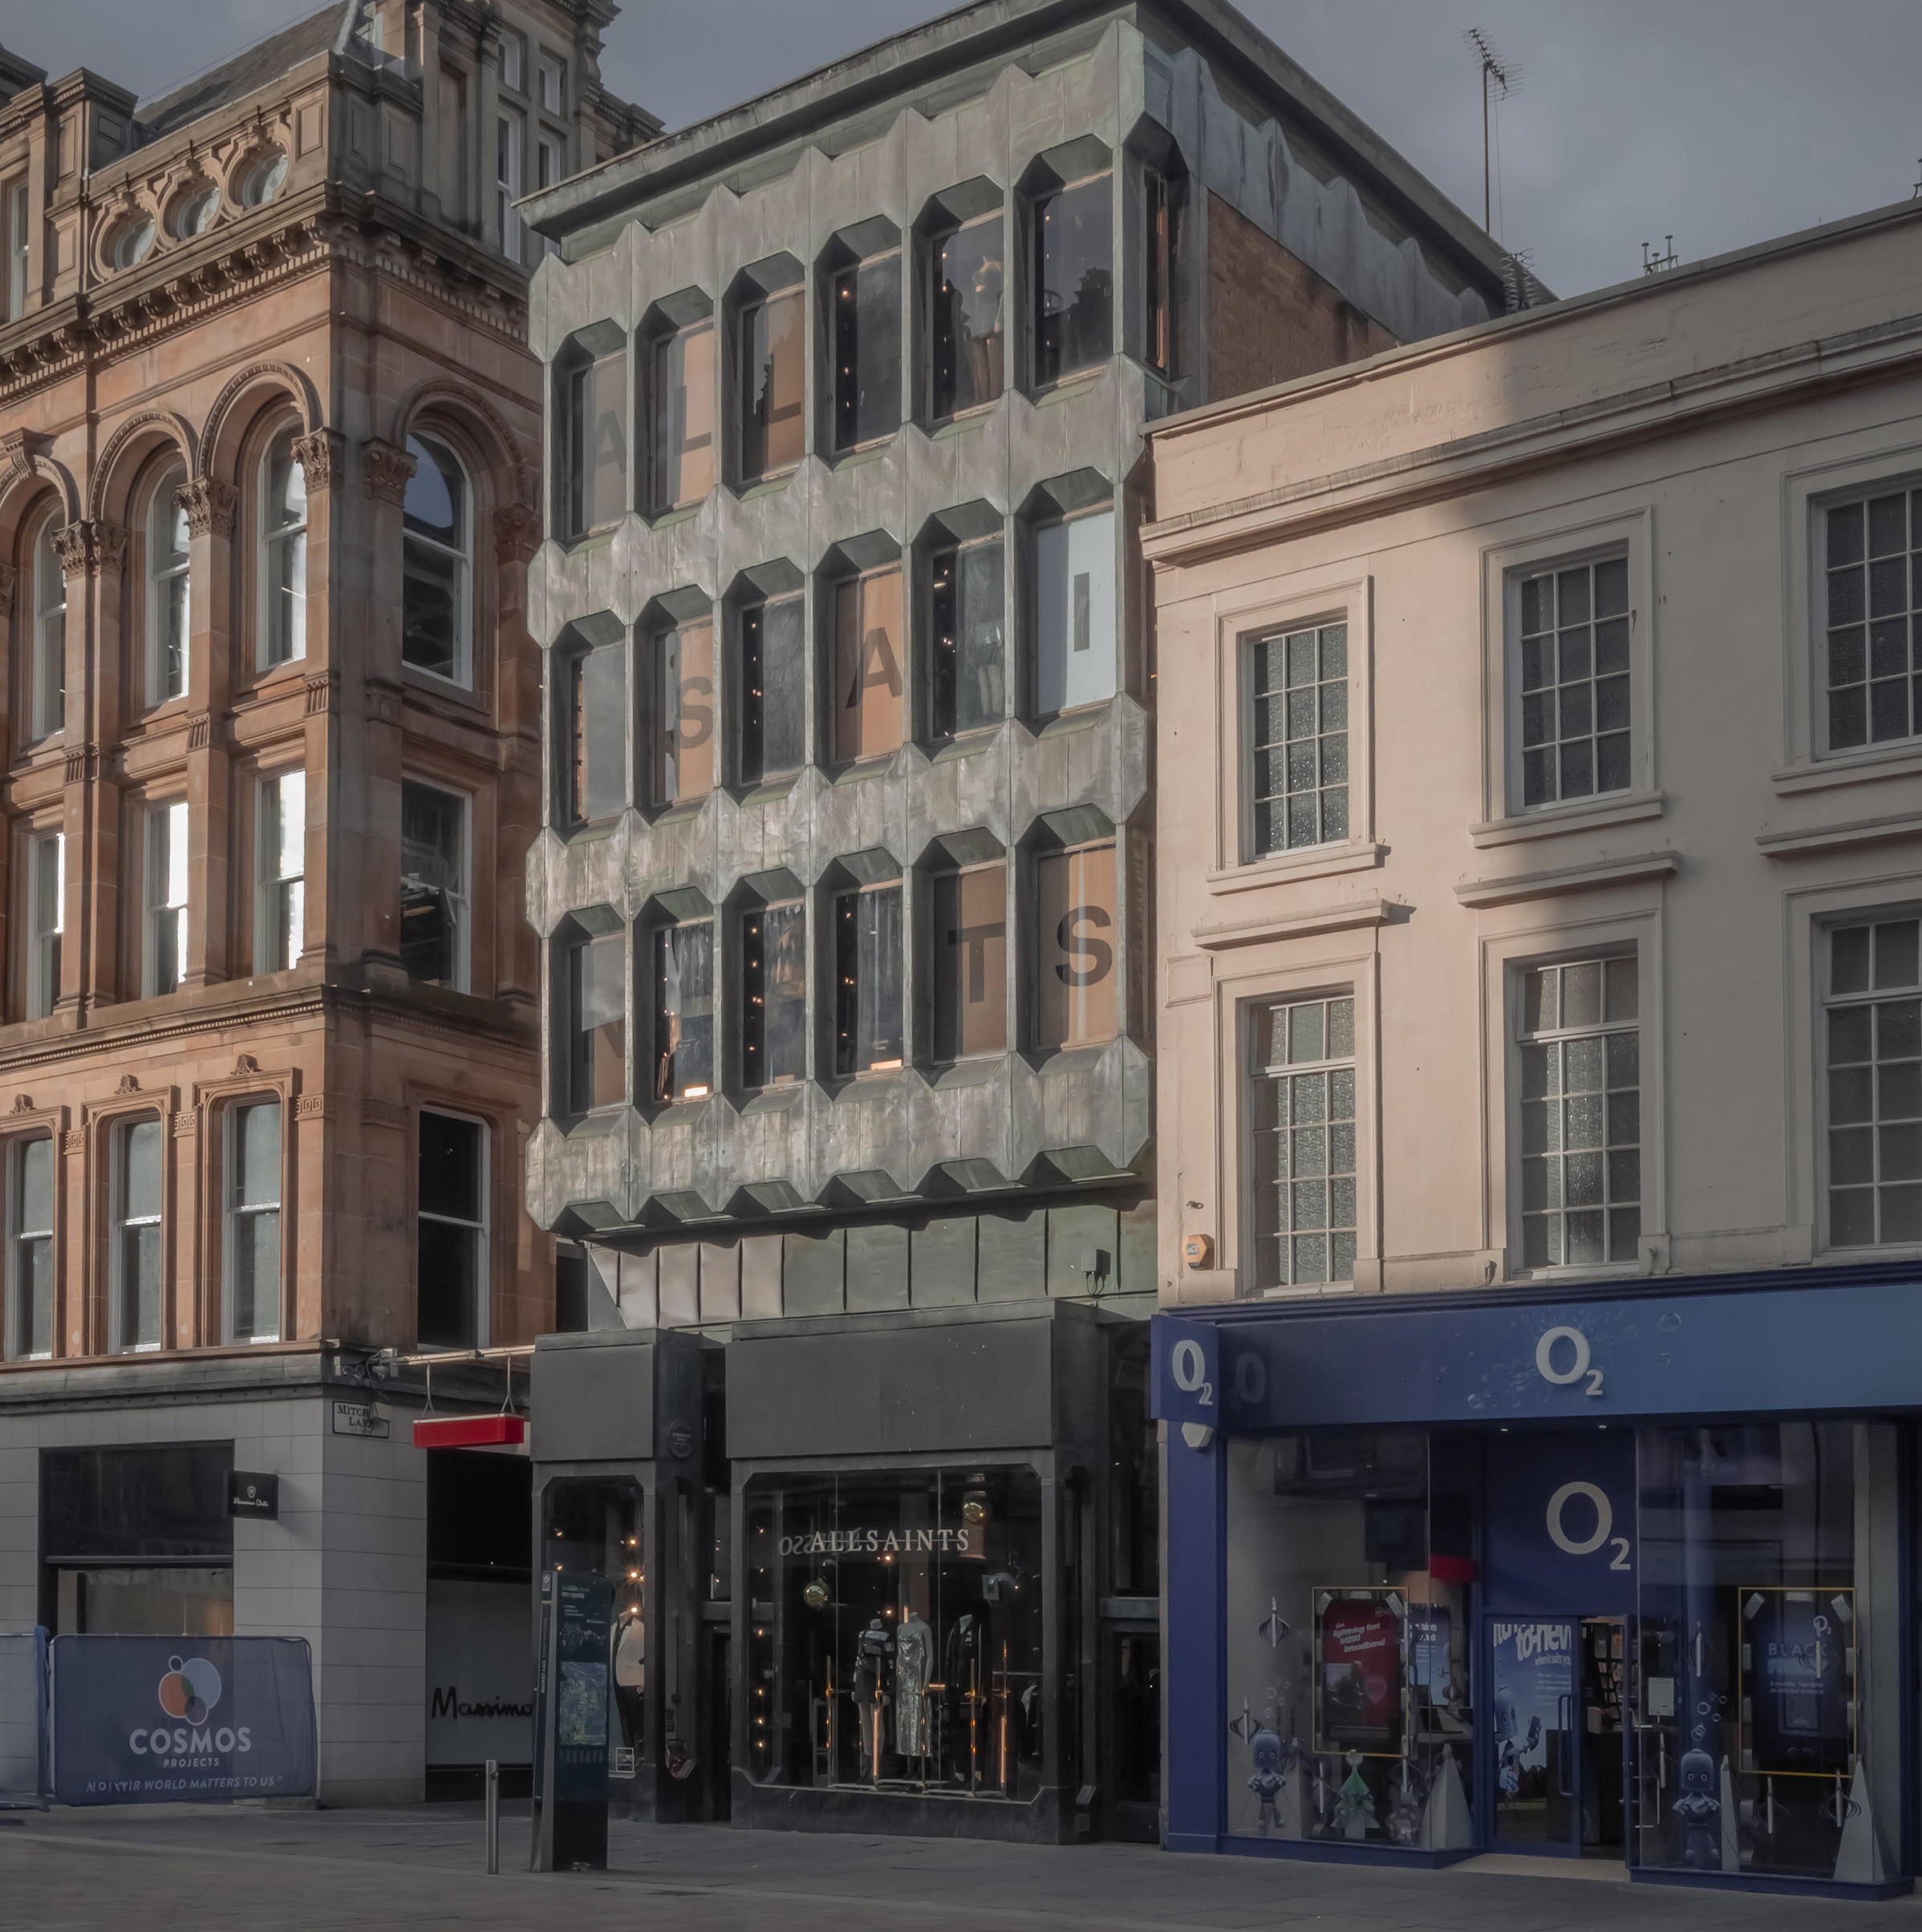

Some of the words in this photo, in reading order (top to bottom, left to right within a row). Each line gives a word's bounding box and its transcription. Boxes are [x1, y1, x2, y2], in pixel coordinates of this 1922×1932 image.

[1535, 1326, 1604, 1396] O2
[1546, 1480, 1631, 1571] O2
[810, 1529, 970, 1552] ALLSAINTS
[431, 1686, 533, 1720] Massimo
[129, 1727, 252, 1755] COSMOS
[164, 1757, 220, 1768] PROJECTS
[144, 1779, 187, 1790] WORLD
[189, 1777, 241, 1788] MATTERS
[244, 1776, 257, 1787] TO
[260, 1776, 274, 1786] US
